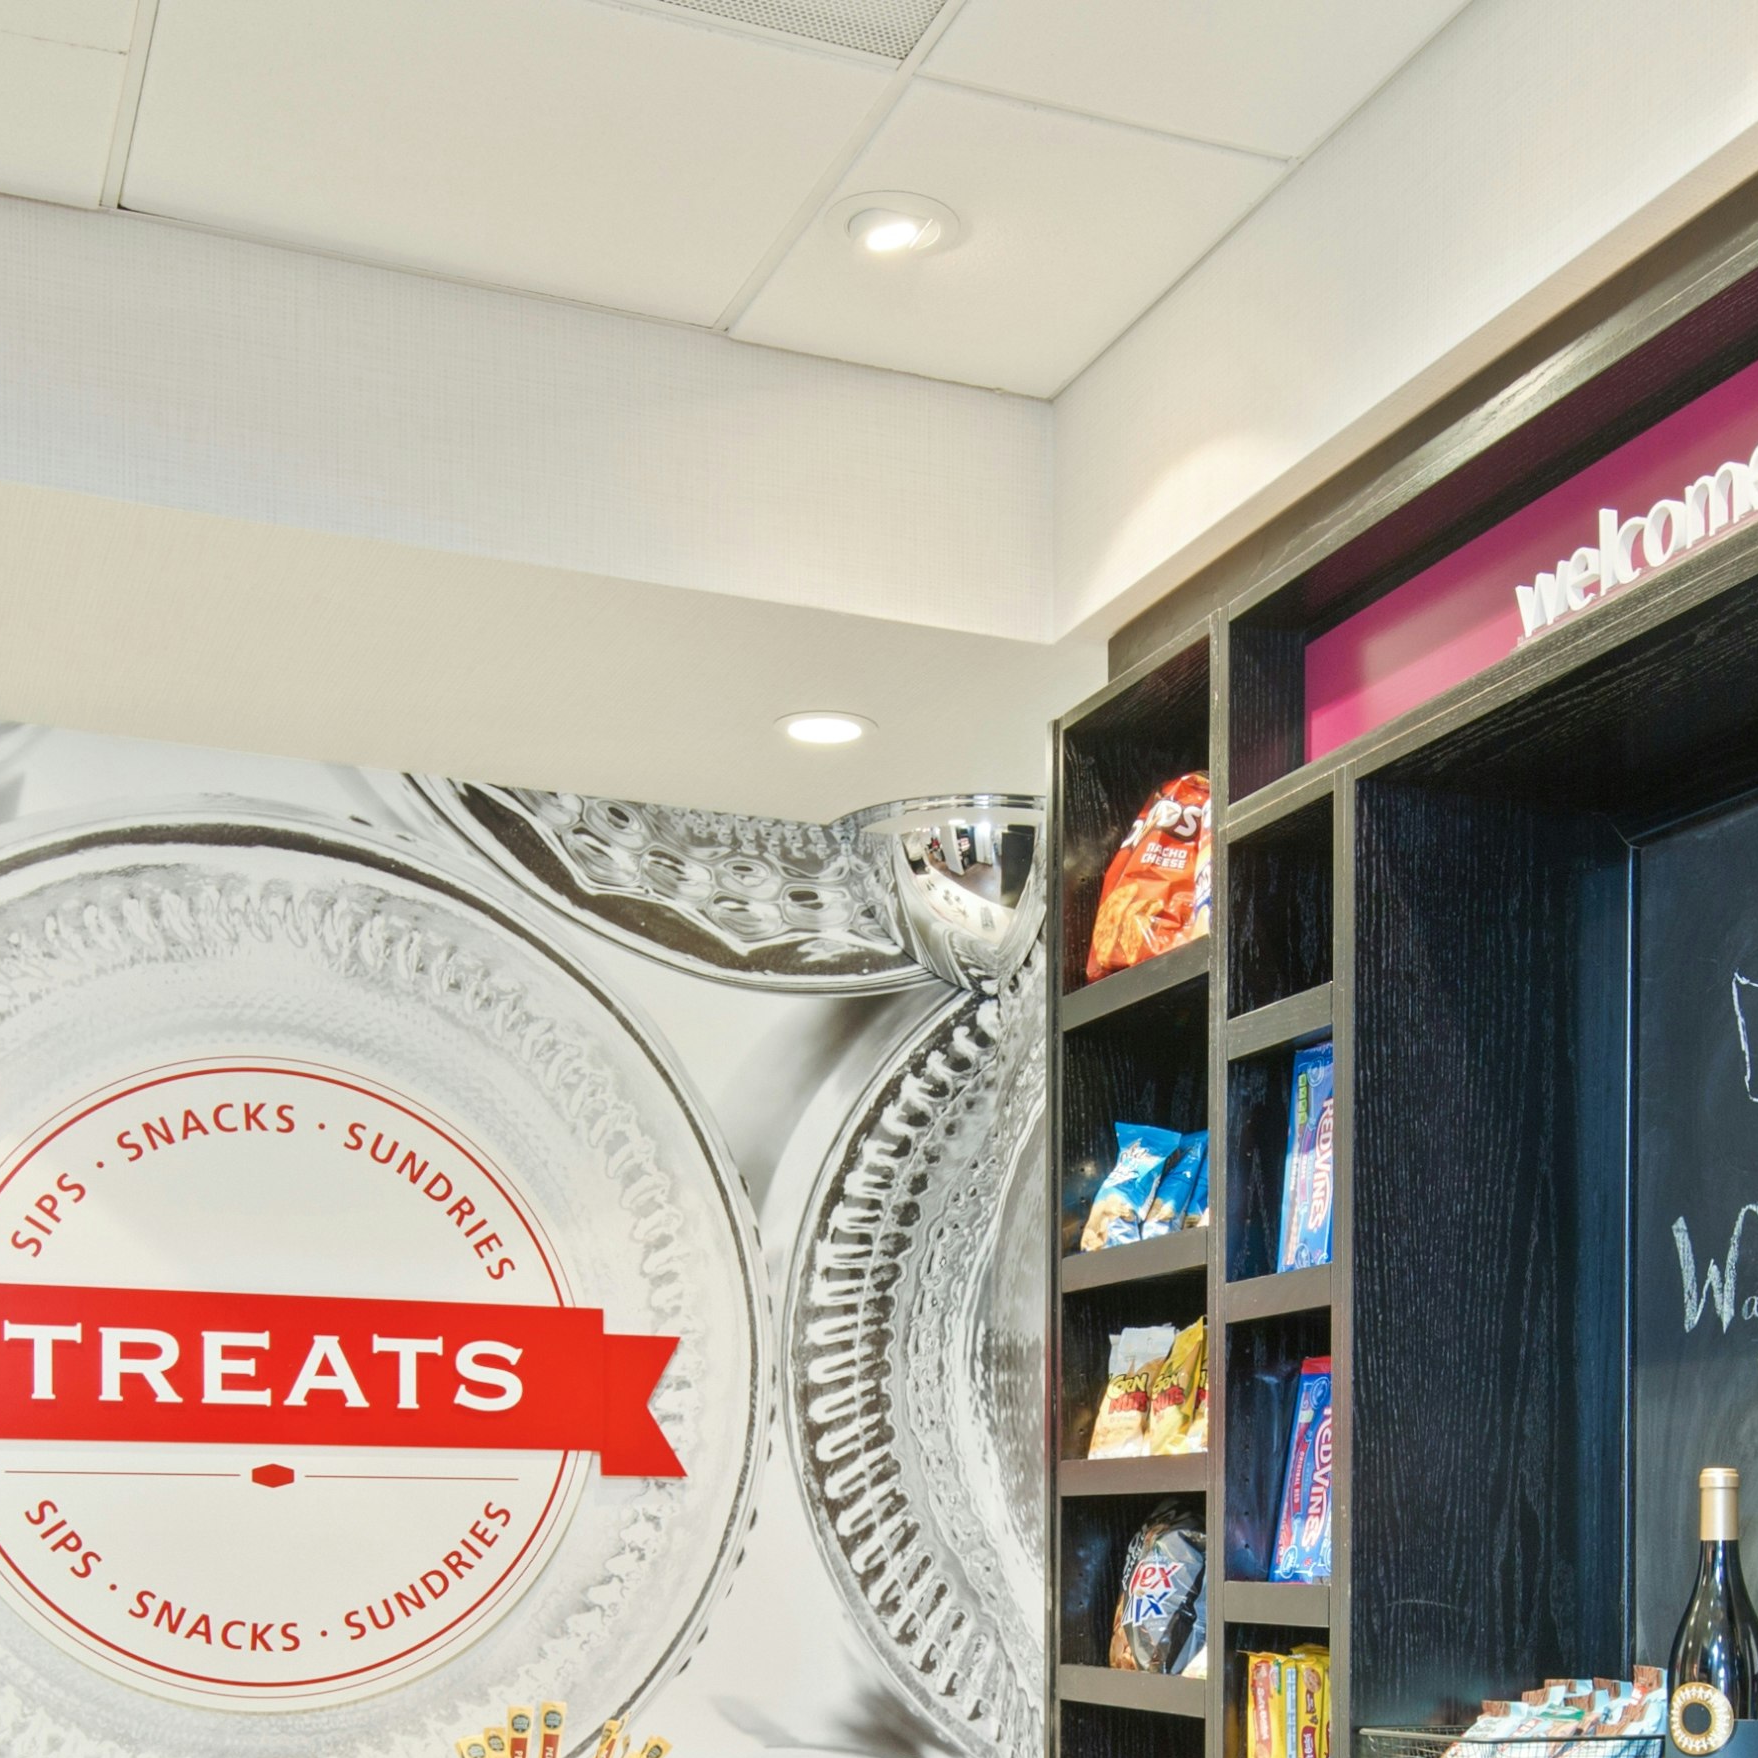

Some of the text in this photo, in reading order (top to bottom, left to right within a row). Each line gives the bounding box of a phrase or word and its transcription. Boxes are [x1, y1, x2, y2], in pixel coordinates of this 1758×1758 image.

[1141, 854, 1187, 869] CHEESE
[1146, 842, 1187, 858] NACHO
[9, 1100, 517, 1283] SIPS SNACKS SUNDRIES
[3, 1320, 525, 1411] TREATS
[25, 1497, 514, 1653] SIPS SNACKS SUNDRIES
